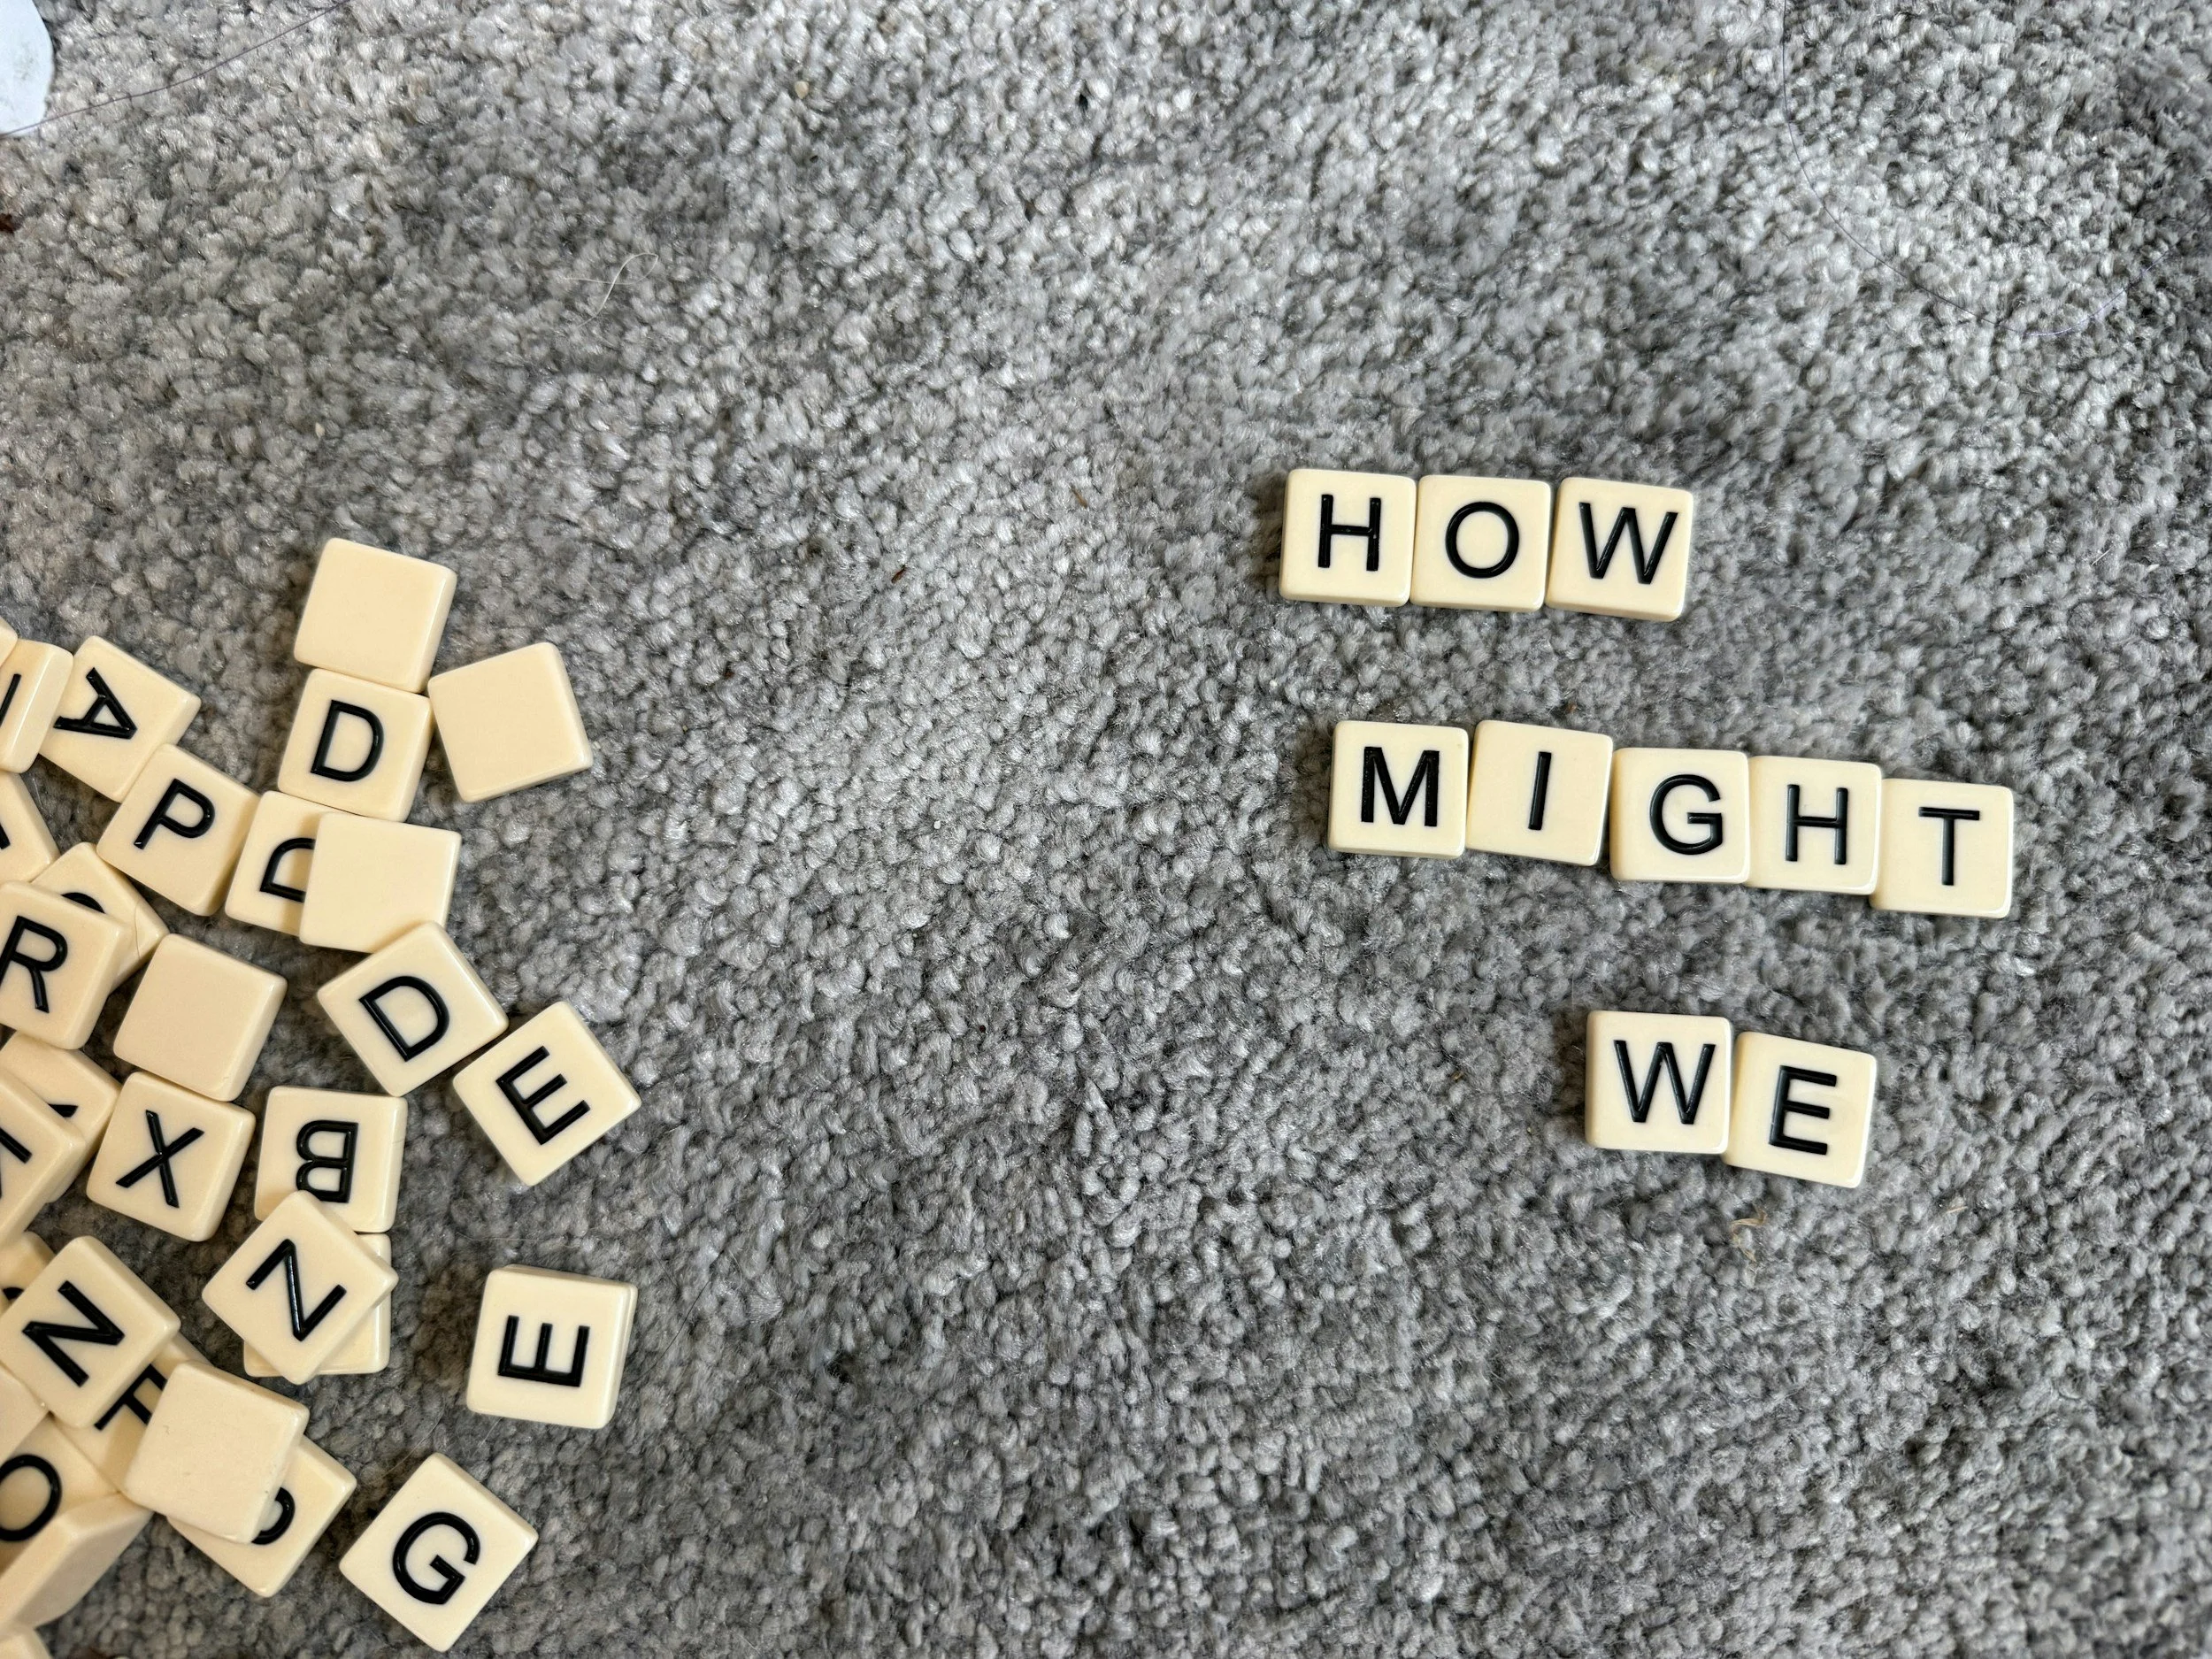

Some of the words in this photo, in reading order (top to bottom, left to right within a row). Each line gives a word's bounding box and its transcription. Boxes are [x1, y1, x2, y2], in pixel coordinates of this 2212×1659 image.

[1318, 494, 1678, 584] HOW
[53, 667, 138, 740] A
[310, 700, 383, 783] D
[134, 779, 215, 849] P
[1361, 747, 1980, 886] MIGHT
[0, 915, 68, 1013] R
[358, 976, 449, 1062] D
[495, 1046, 590, 1145] E
[1614, 1041, 1837, 1156] WE
[116, 1110, 204, 1208] X
[296, 1119, 358, 1203] B
[22, 1280, 125, 1387] N
[497, 1316, 590, 1387] E
[392, 1511, 480, 1604] G
